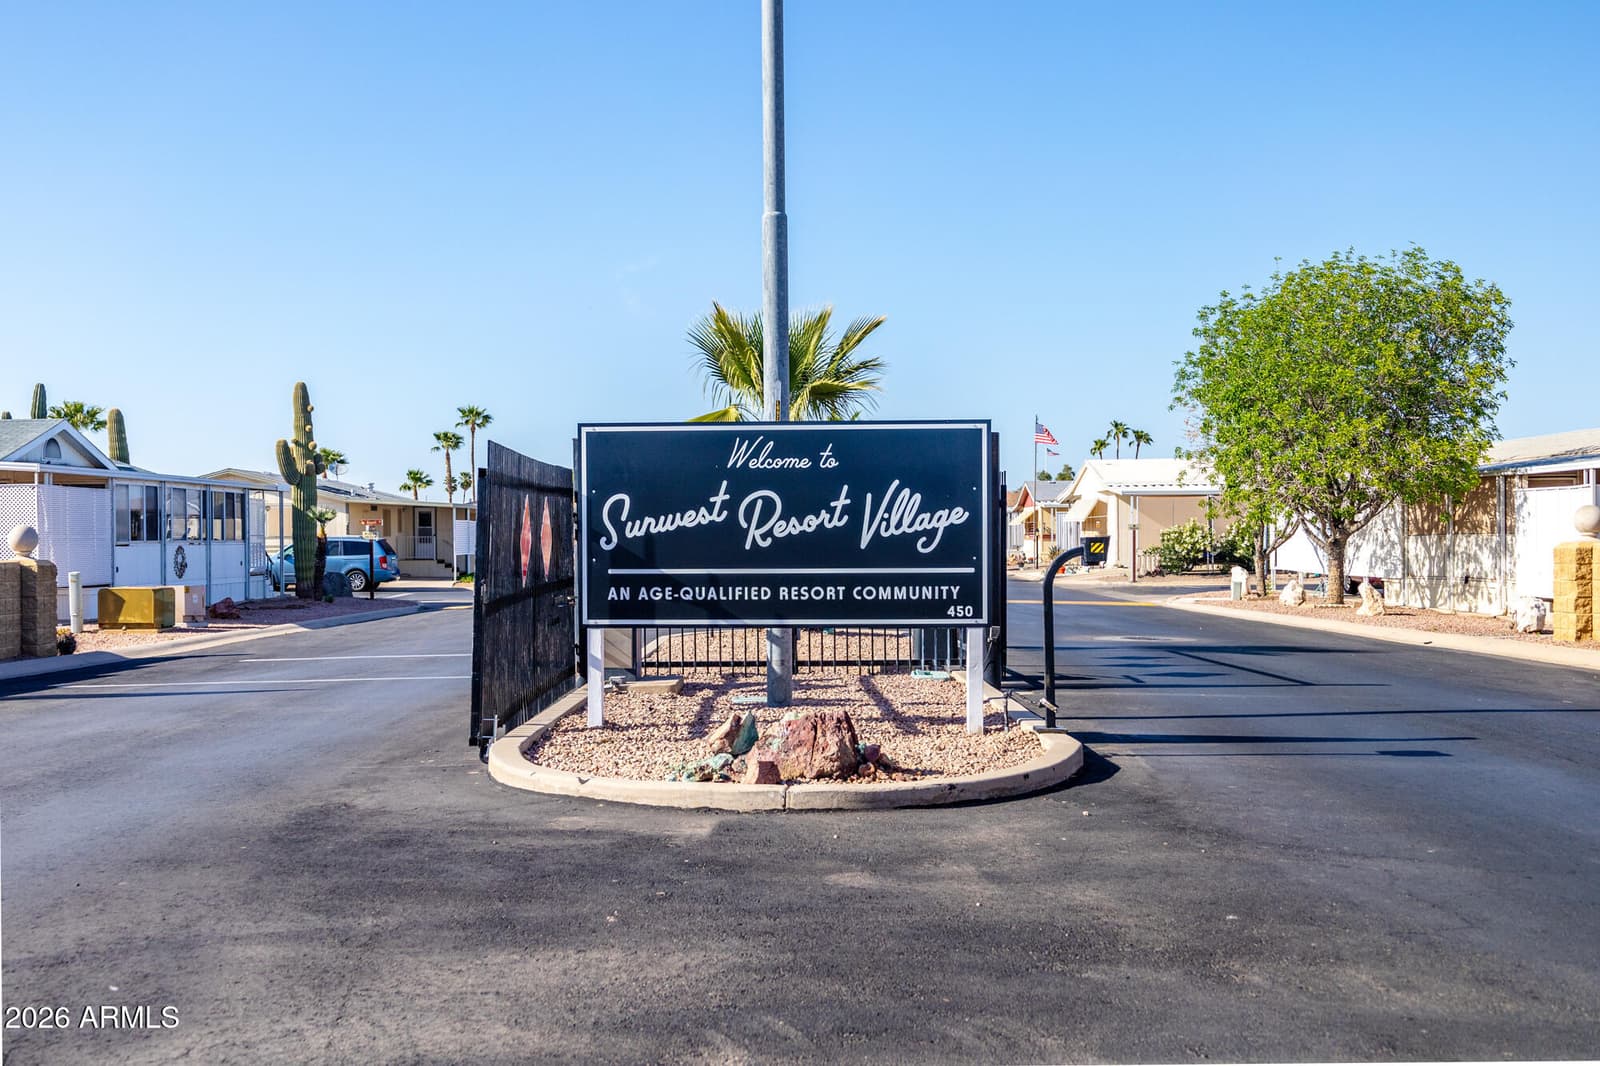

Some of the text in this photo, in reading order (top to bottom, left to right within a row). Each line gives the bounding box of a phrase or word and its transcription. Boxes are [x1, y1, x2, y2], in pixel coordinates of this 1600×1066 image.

[727, 435, 839, 469] Welcome to
[600, 479, 970, 554] Sunwest Resort Village
[607, 585, 960, 601] AN AGE-QUALIFIED RESORT COMMUNITY
[947, 606, 973, 617] 450
